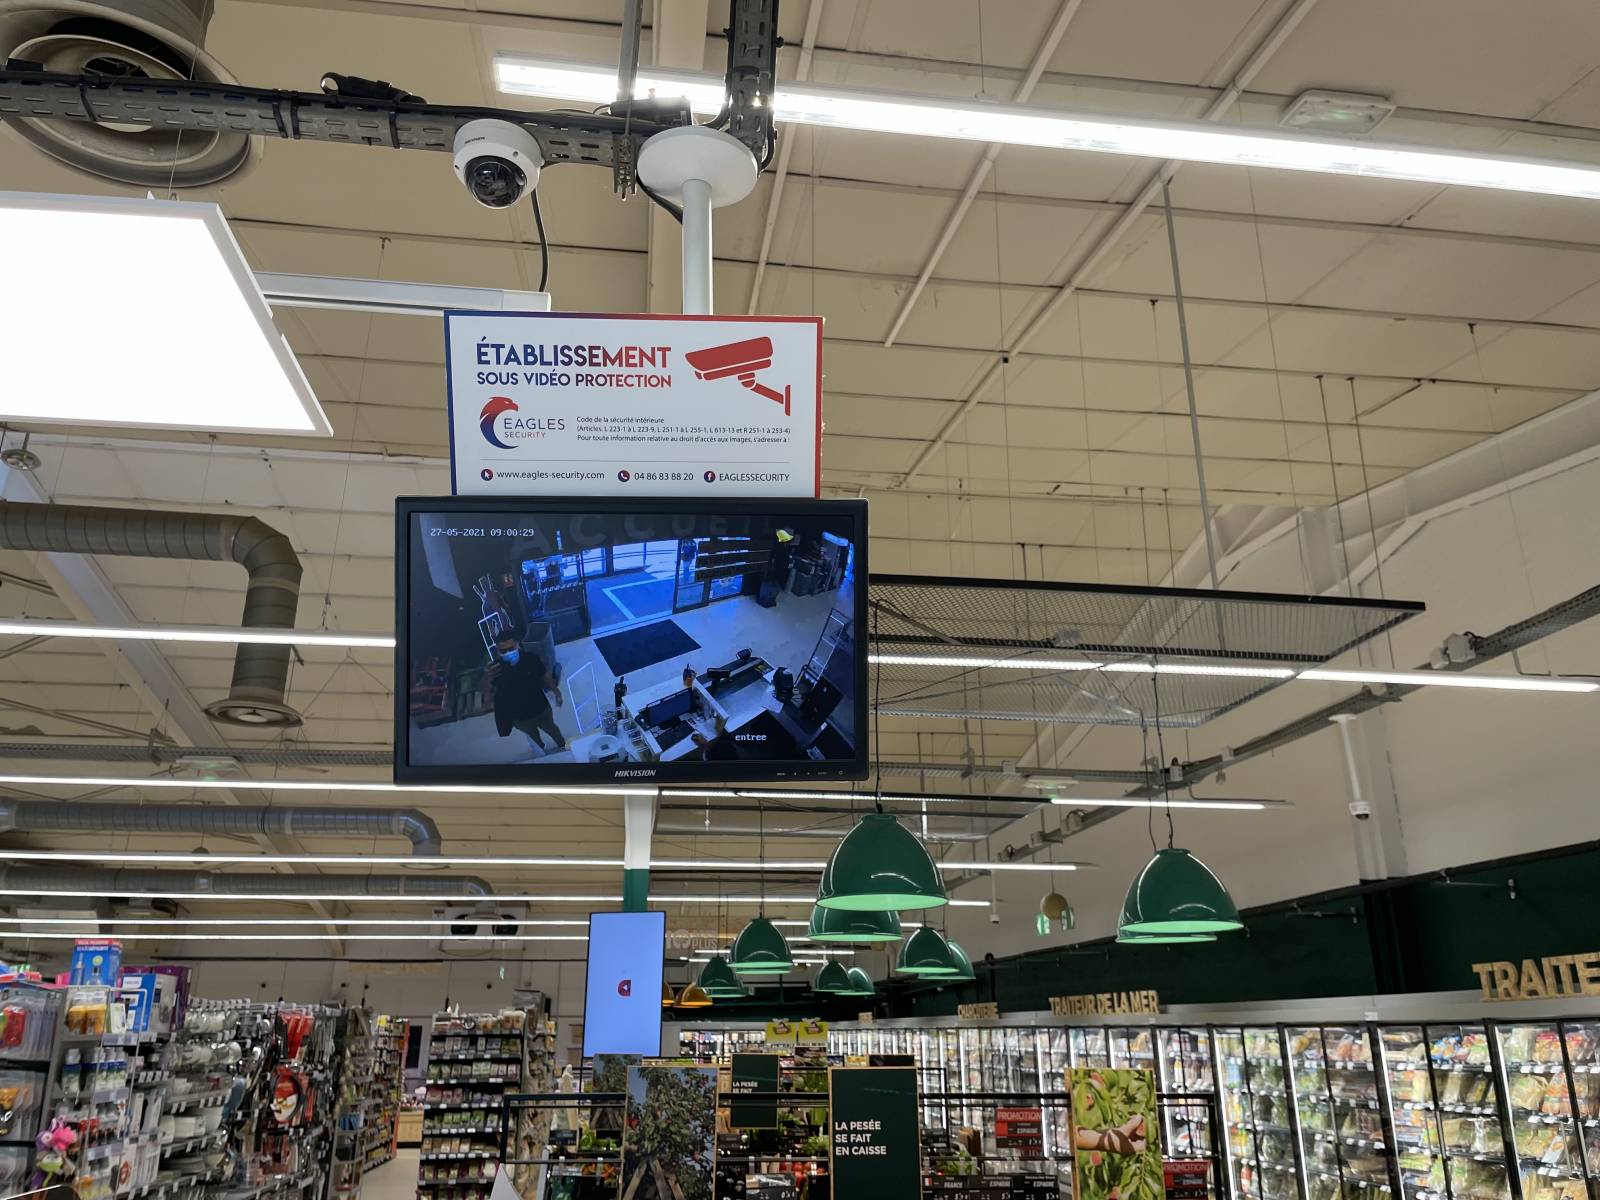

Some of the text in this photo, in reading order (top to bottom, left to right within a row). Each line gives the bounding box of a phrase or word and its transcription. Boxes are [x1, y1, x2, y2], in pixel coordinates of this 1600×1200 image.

[476, 336, 672, 369] ÉTABLISSEMENT
[477, 368, 672, 388] SOUS VIDÉO PROTECTION
[503, 417, 566, 431] EAGLES
[610, 416, 634, 424] sécurité
[635, 416, 665, 424] intérieure
[504, 431, 547, 439] SECURITY
[729, 437, 753, 445] images,
[496, 470, 606, 481] www.eagles-security.com
[634, 472, 694, 481] 04 86 83 88 20
[719, 473, 791, 482] EAGLESSECURITY
[430, 523, 535, 537] 27-05-2021 09:00:29
[735, 732, 767, 742] entree
[614, 768, 657, 778] HIKVISION
[1096, 992, 1113, 1015] DE
[1113, 991, 1130, 1015] LA
[1129, 989, 1159, 1014] MER
[996, 1111, 1042, 1121] PROMOTION
[835, 1119, 882, 1131] LA PESÉE
[835, 1133, 872, 1143] SE FAIT
[835, 1145, 887, 1156] EN CAISSE
